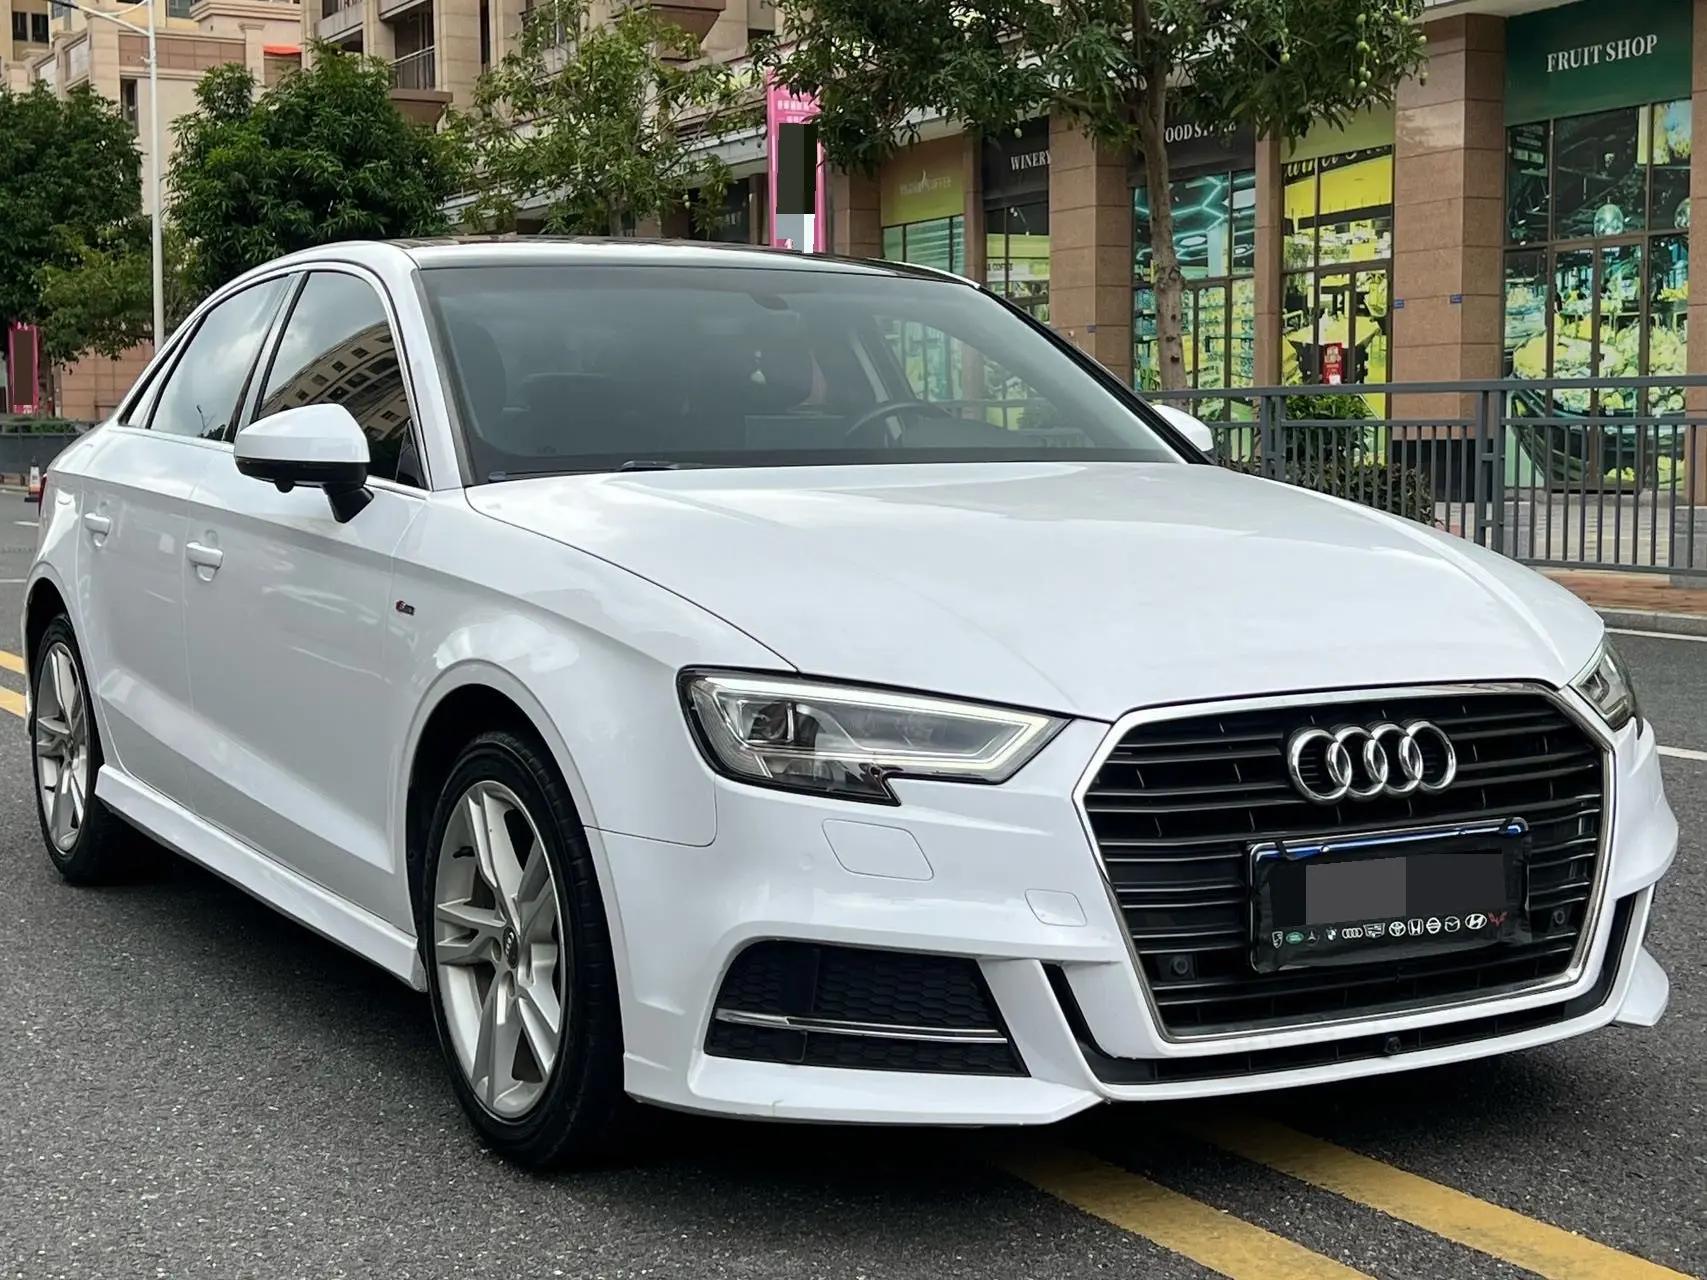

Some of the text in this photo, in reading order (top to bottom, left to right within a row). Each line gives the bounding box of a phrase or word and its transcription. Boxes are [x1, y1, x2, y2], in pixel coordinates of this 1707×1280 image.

[1546, 34, 1658, 72] FRUIT SHOP
[1165, 124, 1193, 143] OOD
